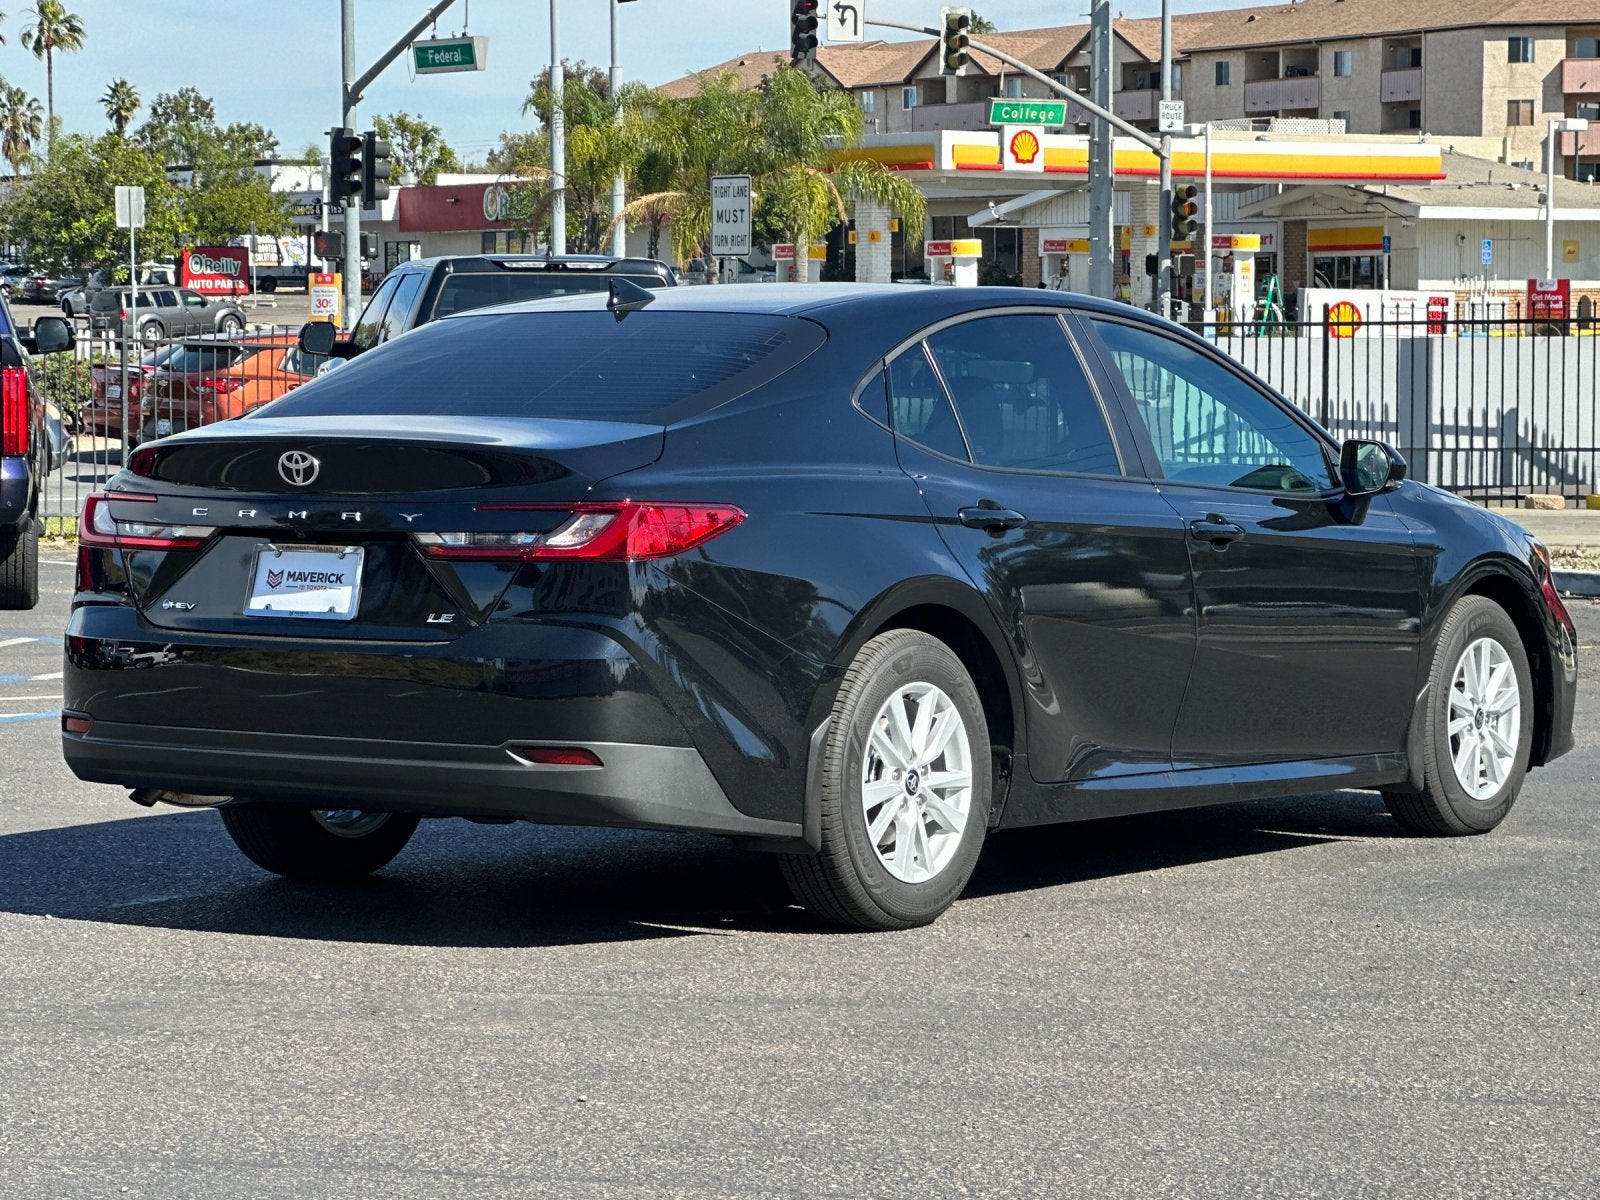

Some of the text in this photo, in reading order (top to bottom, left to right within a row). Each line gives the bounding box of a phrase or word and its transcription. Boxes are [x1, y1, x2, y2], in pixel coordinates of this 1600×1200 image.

[428, 48, 462, 64] Federal
[1161, 103, 1182, 111] TRUCK
[1001, 106, 1055, 123] College
[1161, 112, 1182, 120] ROUTE
[714, 185, 748, 198] RIGHT LANE
[716, 208, 745, 224] MUST
[714, 234, 747, 247] TURN RIGHT
[189, 254, 241, 276] O'Reilly
[188, 279, 245, 289] AUTO PARTS
[1531, 293, 1563, 301] Get More
[192, 507, 423, 522] CAMRY
[286, 570, 345, 584] MAVERICK
[426, 613, 456, 623] LE
